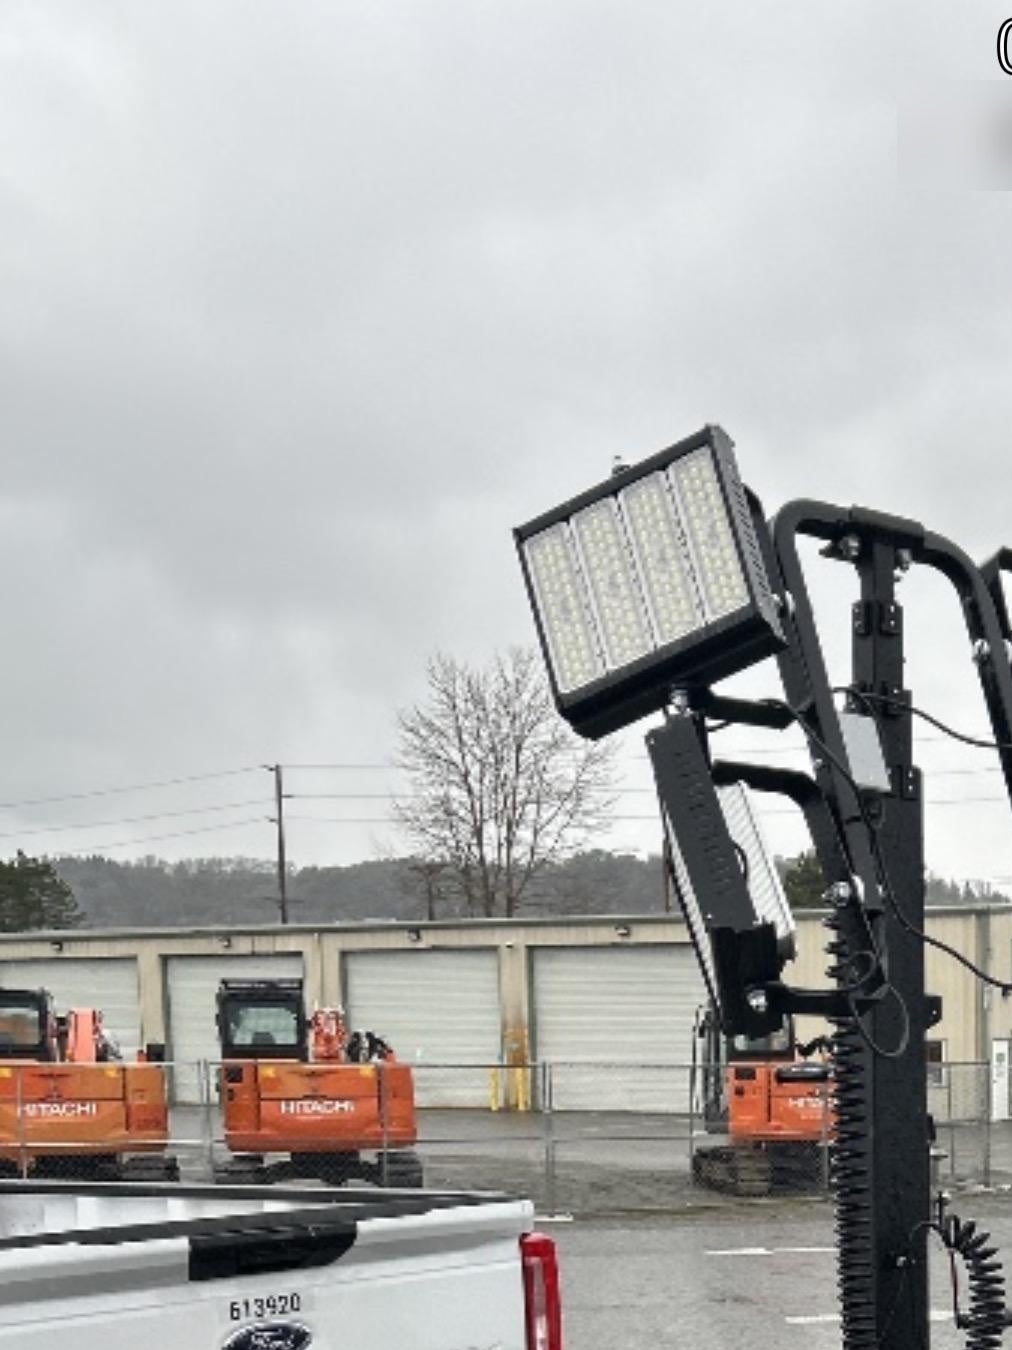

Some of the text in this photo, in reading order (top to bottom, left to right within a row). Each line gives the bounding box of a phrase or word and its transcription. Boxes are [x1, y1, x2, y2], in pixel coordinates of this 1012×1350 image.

[16, 1102, 97, 1118] HITACHI
[280, 1100, 355, 1115] HITACHI
[229, 1292, 301, 1321] 613920
